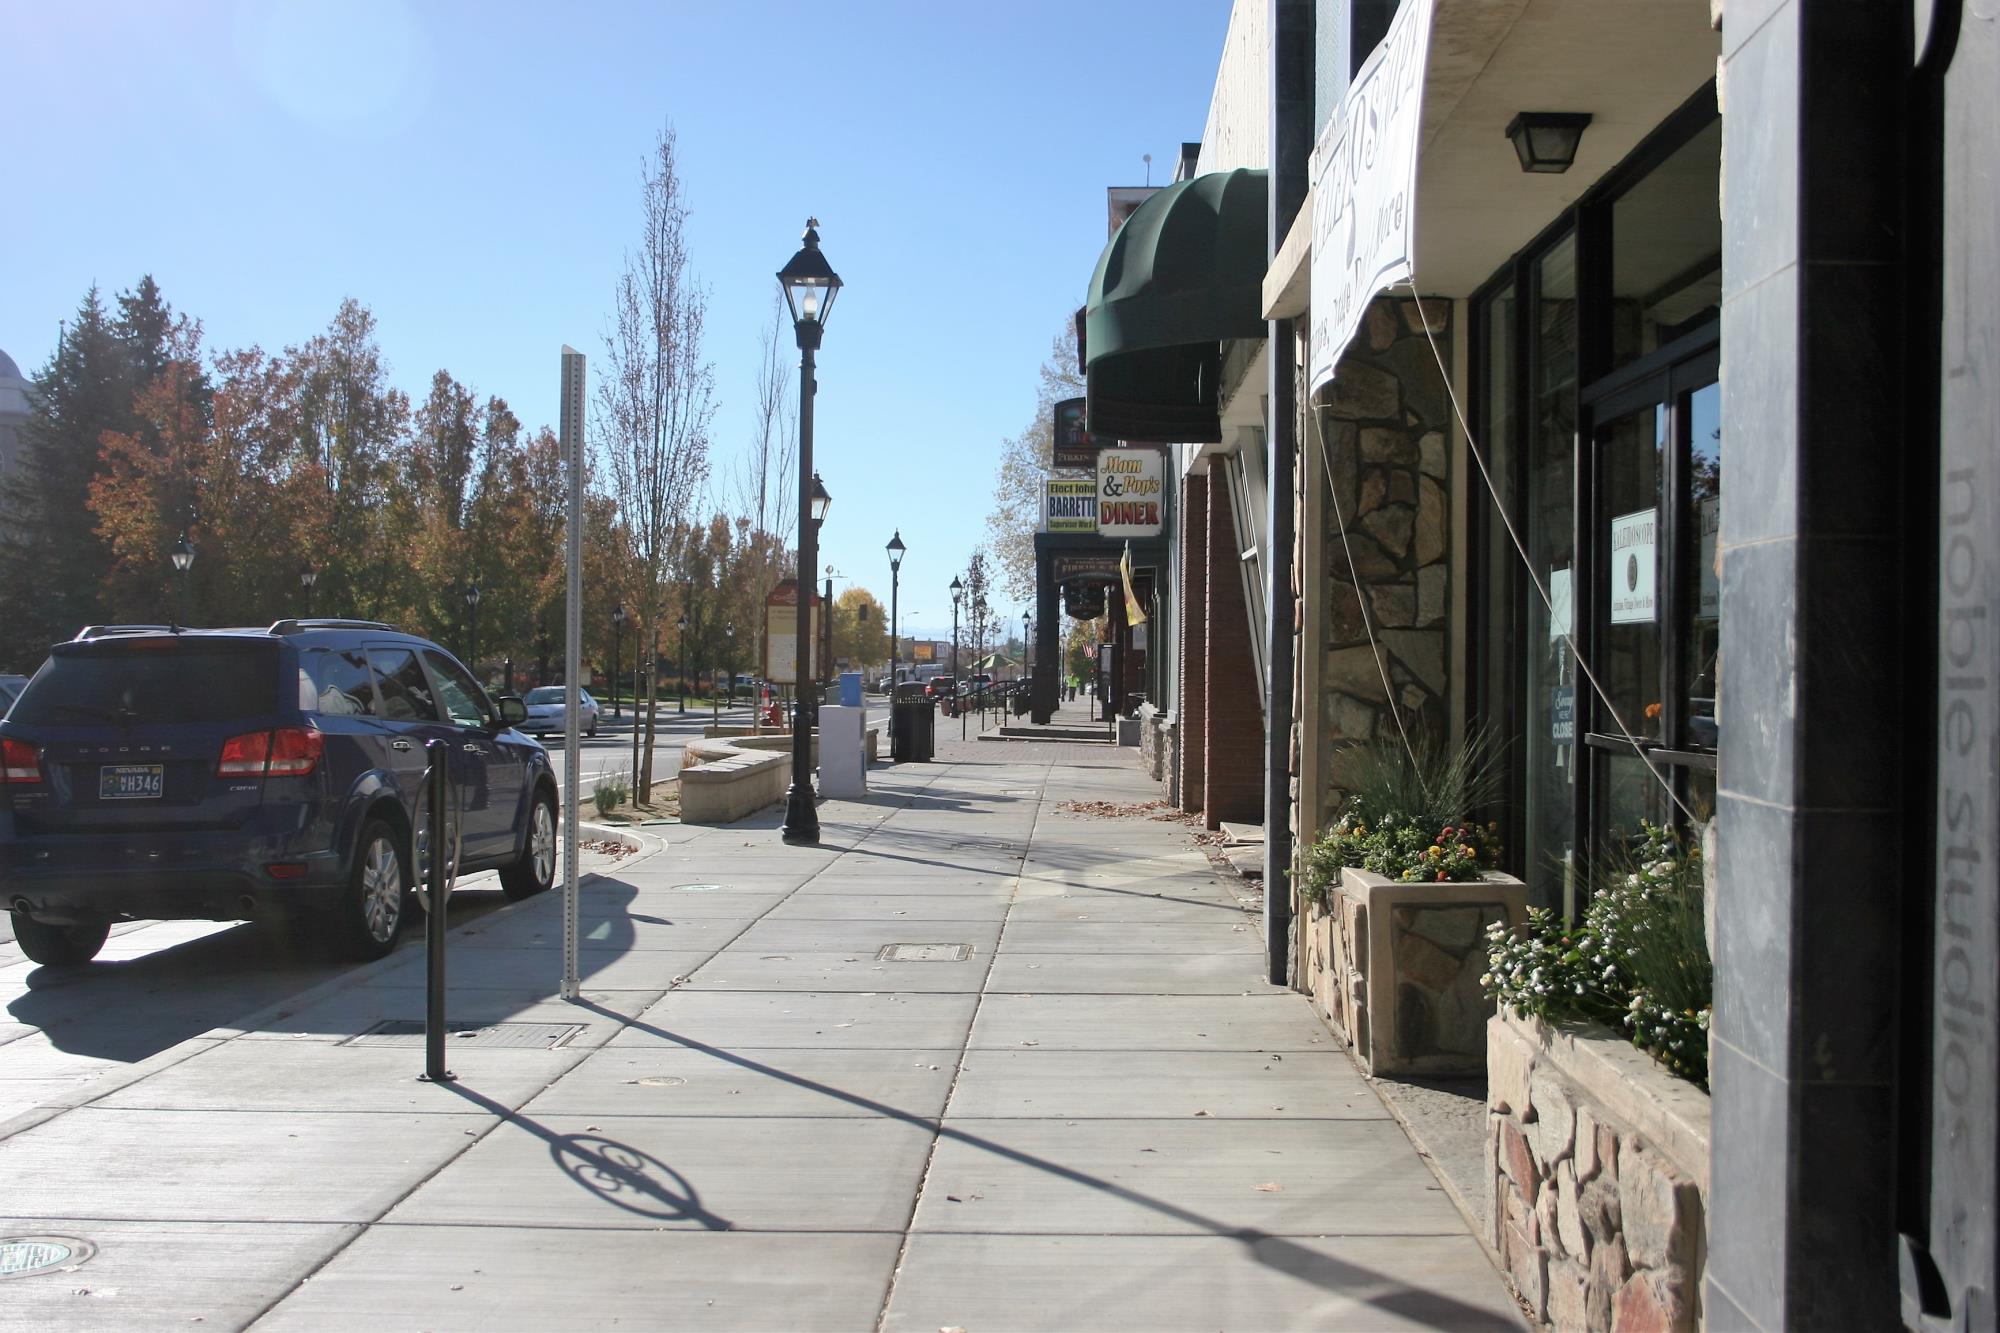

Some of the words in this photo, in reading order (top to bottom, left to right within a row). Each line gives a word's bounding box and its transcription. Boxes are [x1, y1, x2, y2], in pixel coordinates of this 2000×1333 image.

[1101, 456, 1142, 473] Mom
[1050, 483, 1073, 494] Elect
[1075, 483, 1096, 494] John
[1103, 475, 1123, 497] &
[1123, 476, 1160, 496] Pop's
[1101, 501, 1160, 525] DINER
[1944, 468, 1986, 760] noble
[1552, 721, 1573, 738] CLOSE
[1941, 790, 1986, 1150] studios
